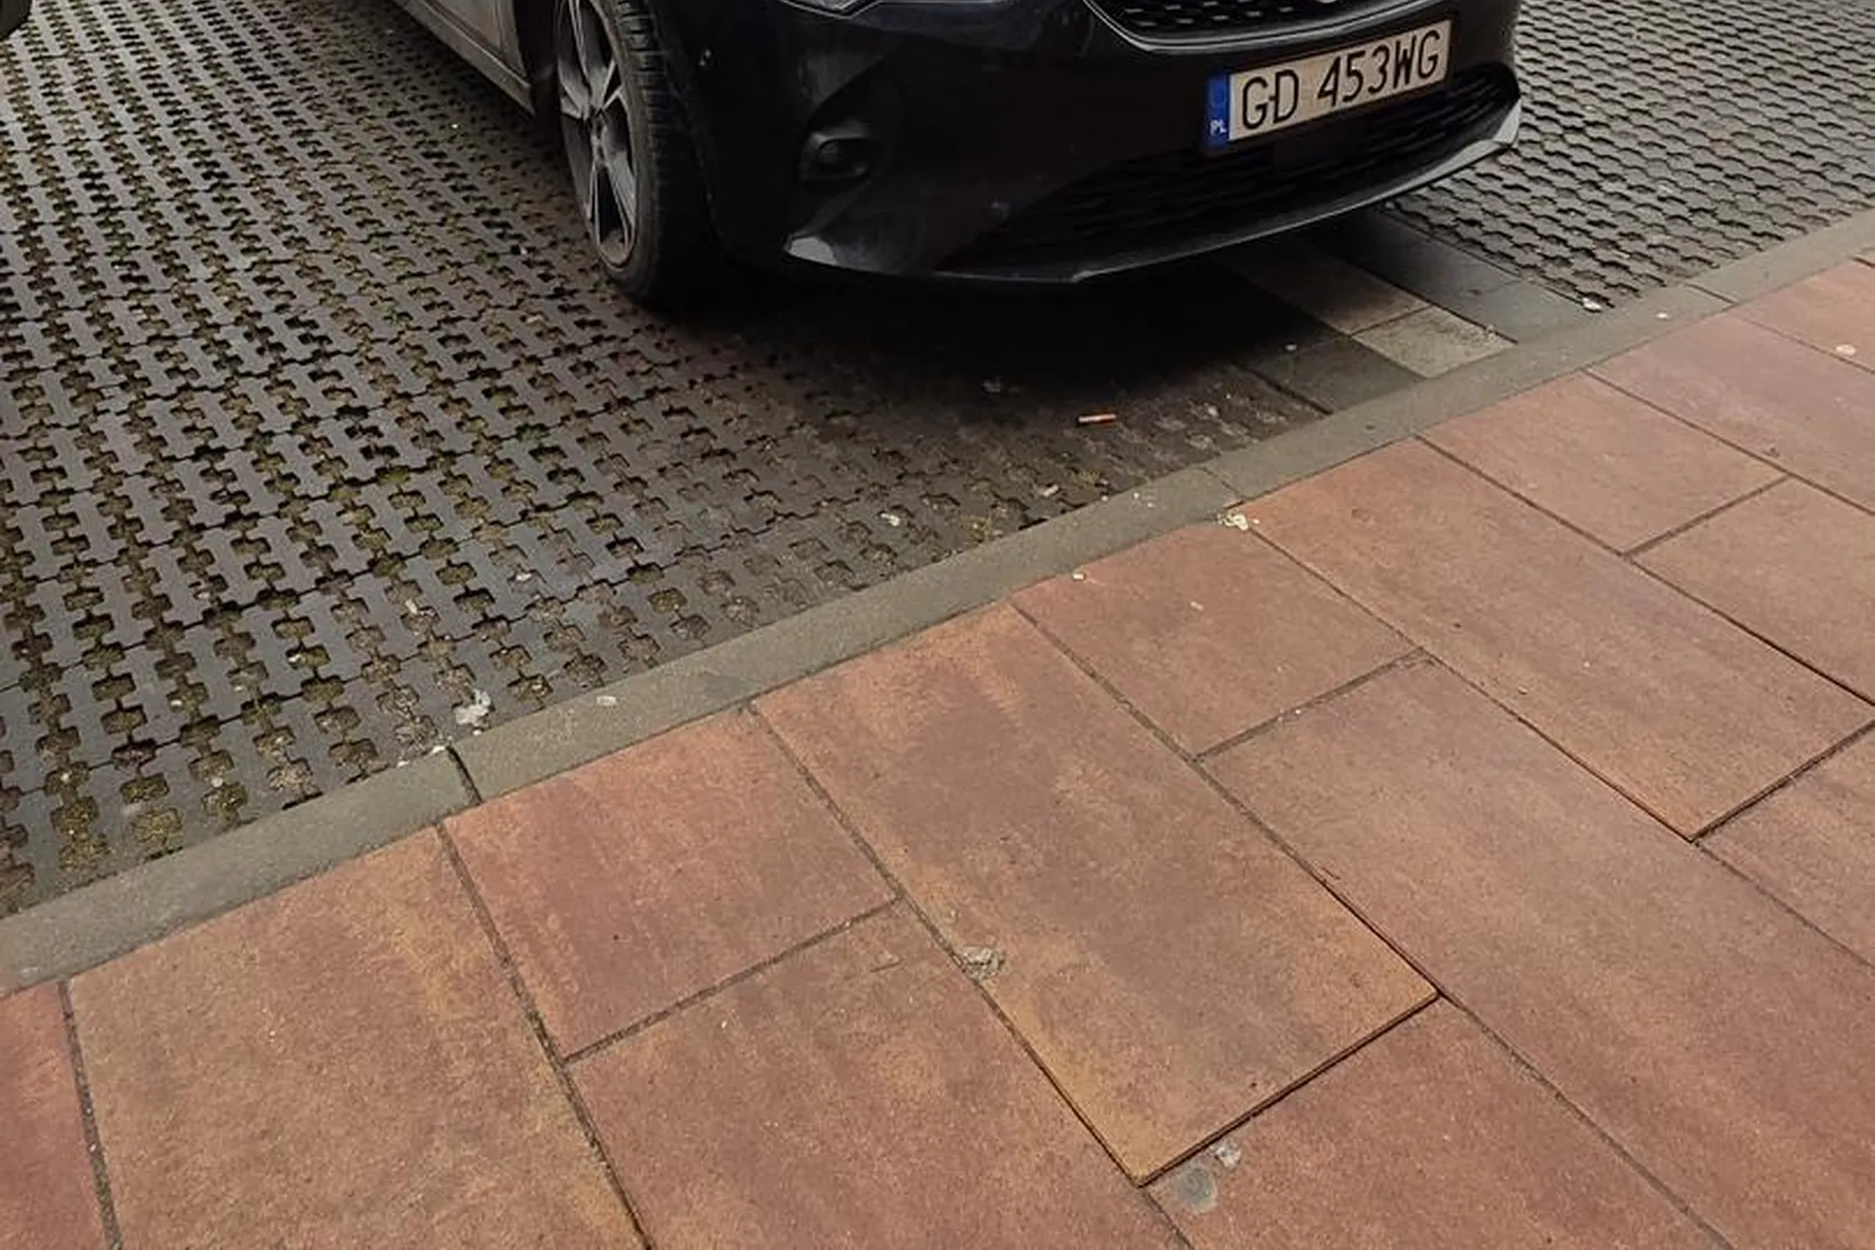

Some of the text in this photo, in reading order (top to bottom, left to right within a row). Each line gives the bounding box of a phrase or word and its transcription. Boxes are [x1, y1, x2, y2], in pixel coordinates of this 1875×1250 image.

[1241, 29, 1441, 130] GD 453WG
[1209, 118, 1228, 136] PL
